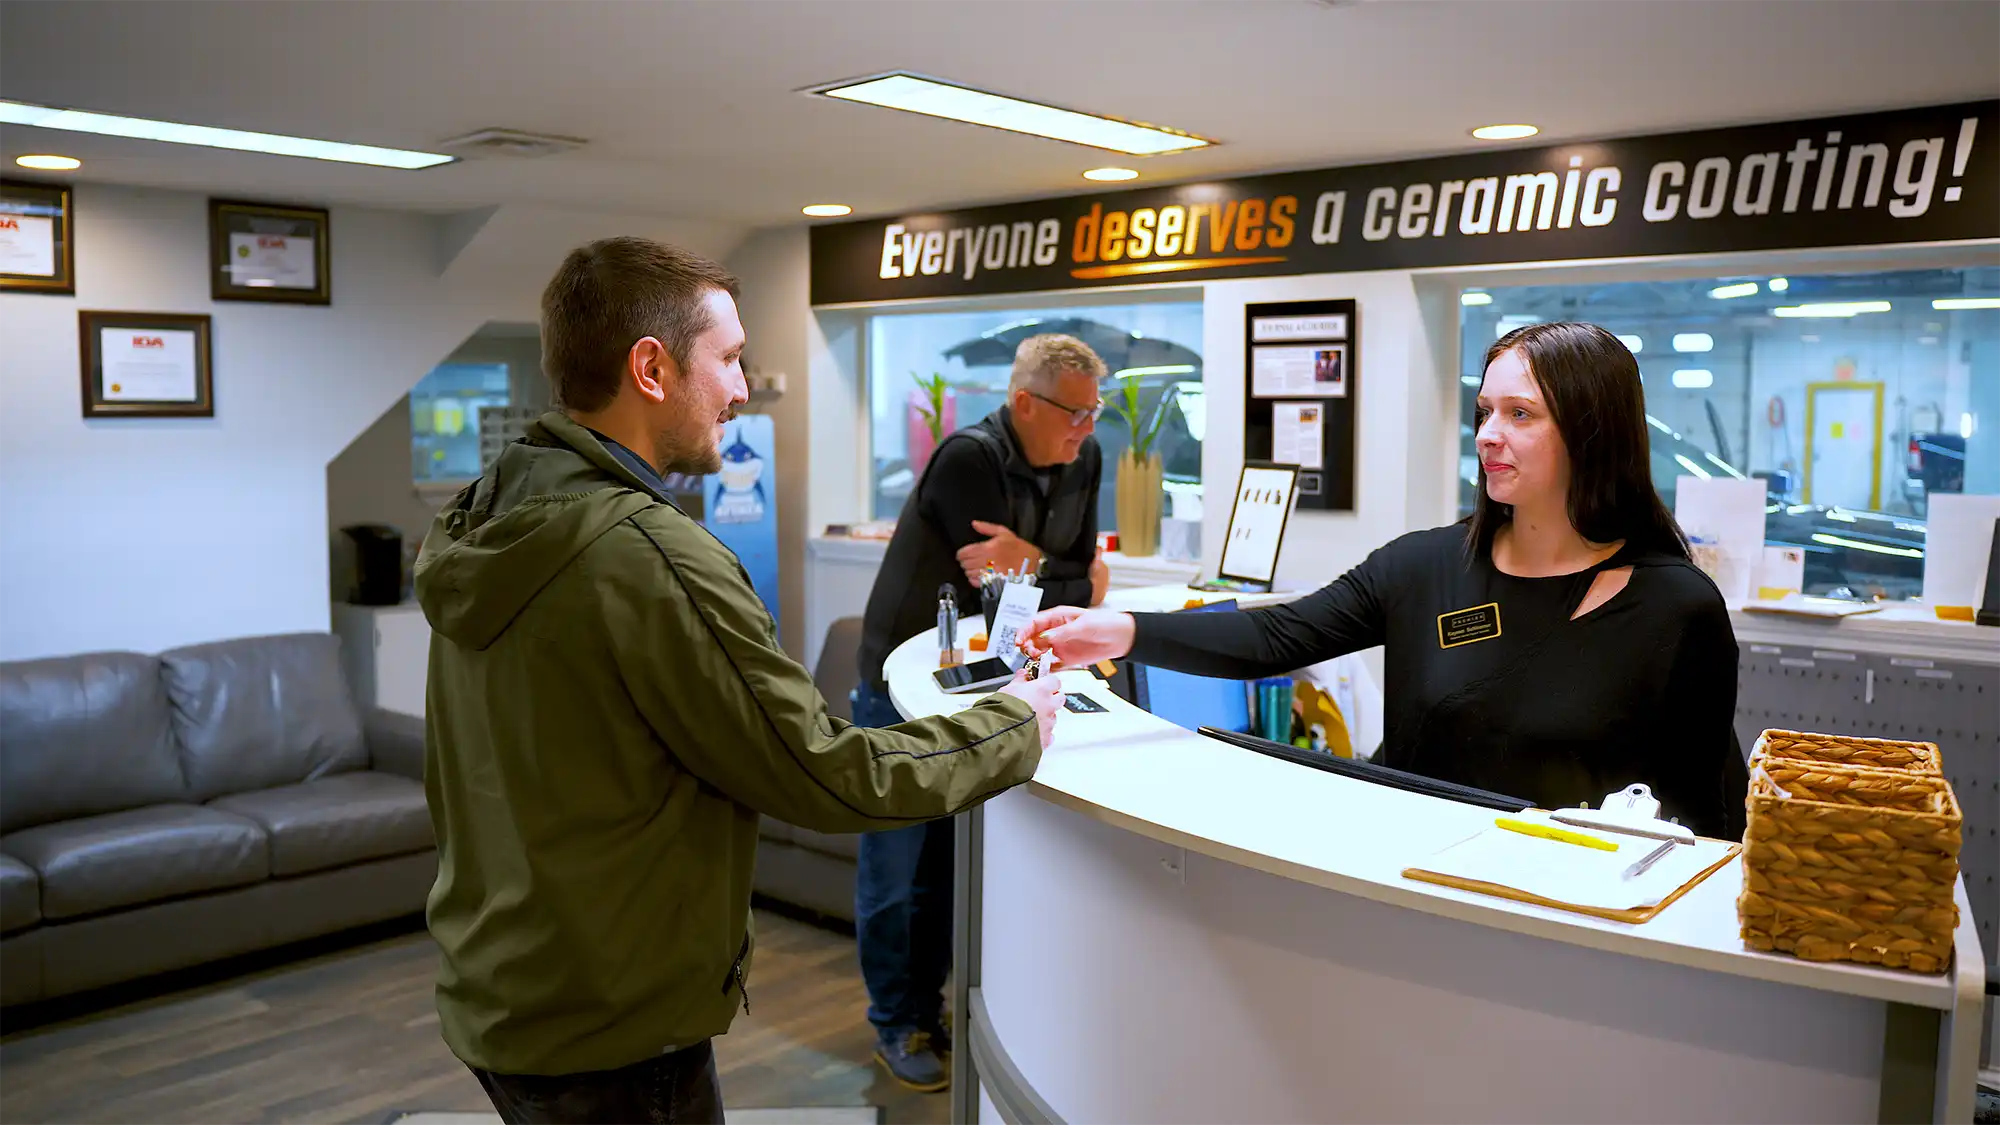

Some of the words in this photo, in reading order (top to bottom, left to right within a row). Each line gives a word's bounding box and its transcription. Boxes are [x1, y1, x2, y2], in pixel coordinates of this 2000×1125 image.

[879, 218, 1060, 280] Everyone
[1071, 195, 1297, 262] deserves
[1311, 190, 1347, 245] a
[1361, 155, 1622, 242] ceramic
[1641, 118, 1979, 223] coating!
